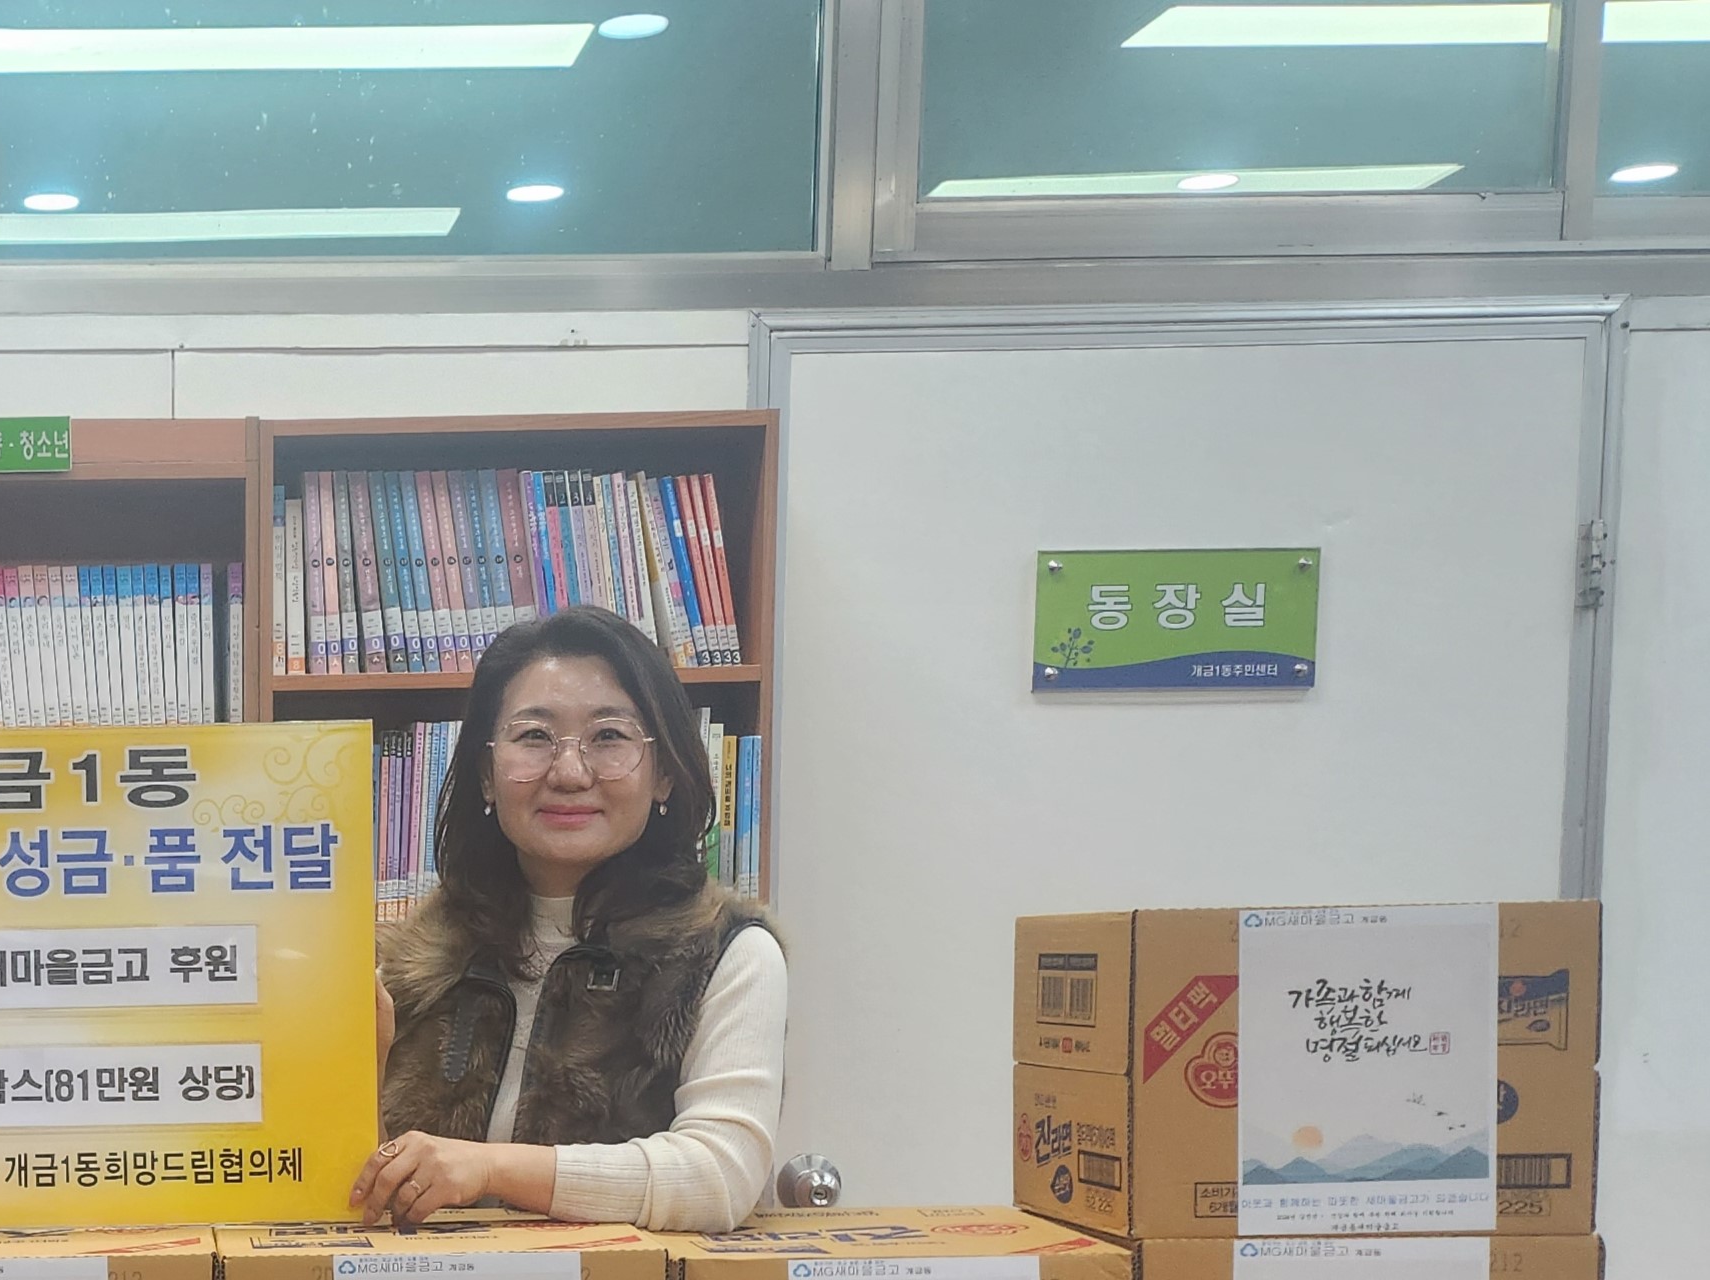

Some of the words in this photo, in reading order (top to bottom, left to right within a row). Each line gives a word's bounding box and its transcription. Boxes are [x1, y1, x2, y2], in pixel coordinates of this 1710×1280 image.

[702, 651, 710, 663] 3
[713, 651, 721, 663] 3
[723, 651, 731, 662] 3
[732, 651, 741, 663] 3
[1191, 663, 1278, 678] 개금1동주민센터
[221, 823, 340, 891] 전달
[169, 944, 239, 984] 후원
[1153, 980, 1217, 1049] 멀티팩
[1313, 1004, 1389, 1035] 행복한
[1034, 1115, 1073, 1166] 진라면
[1497, 1199, 1543, 1214] 225
